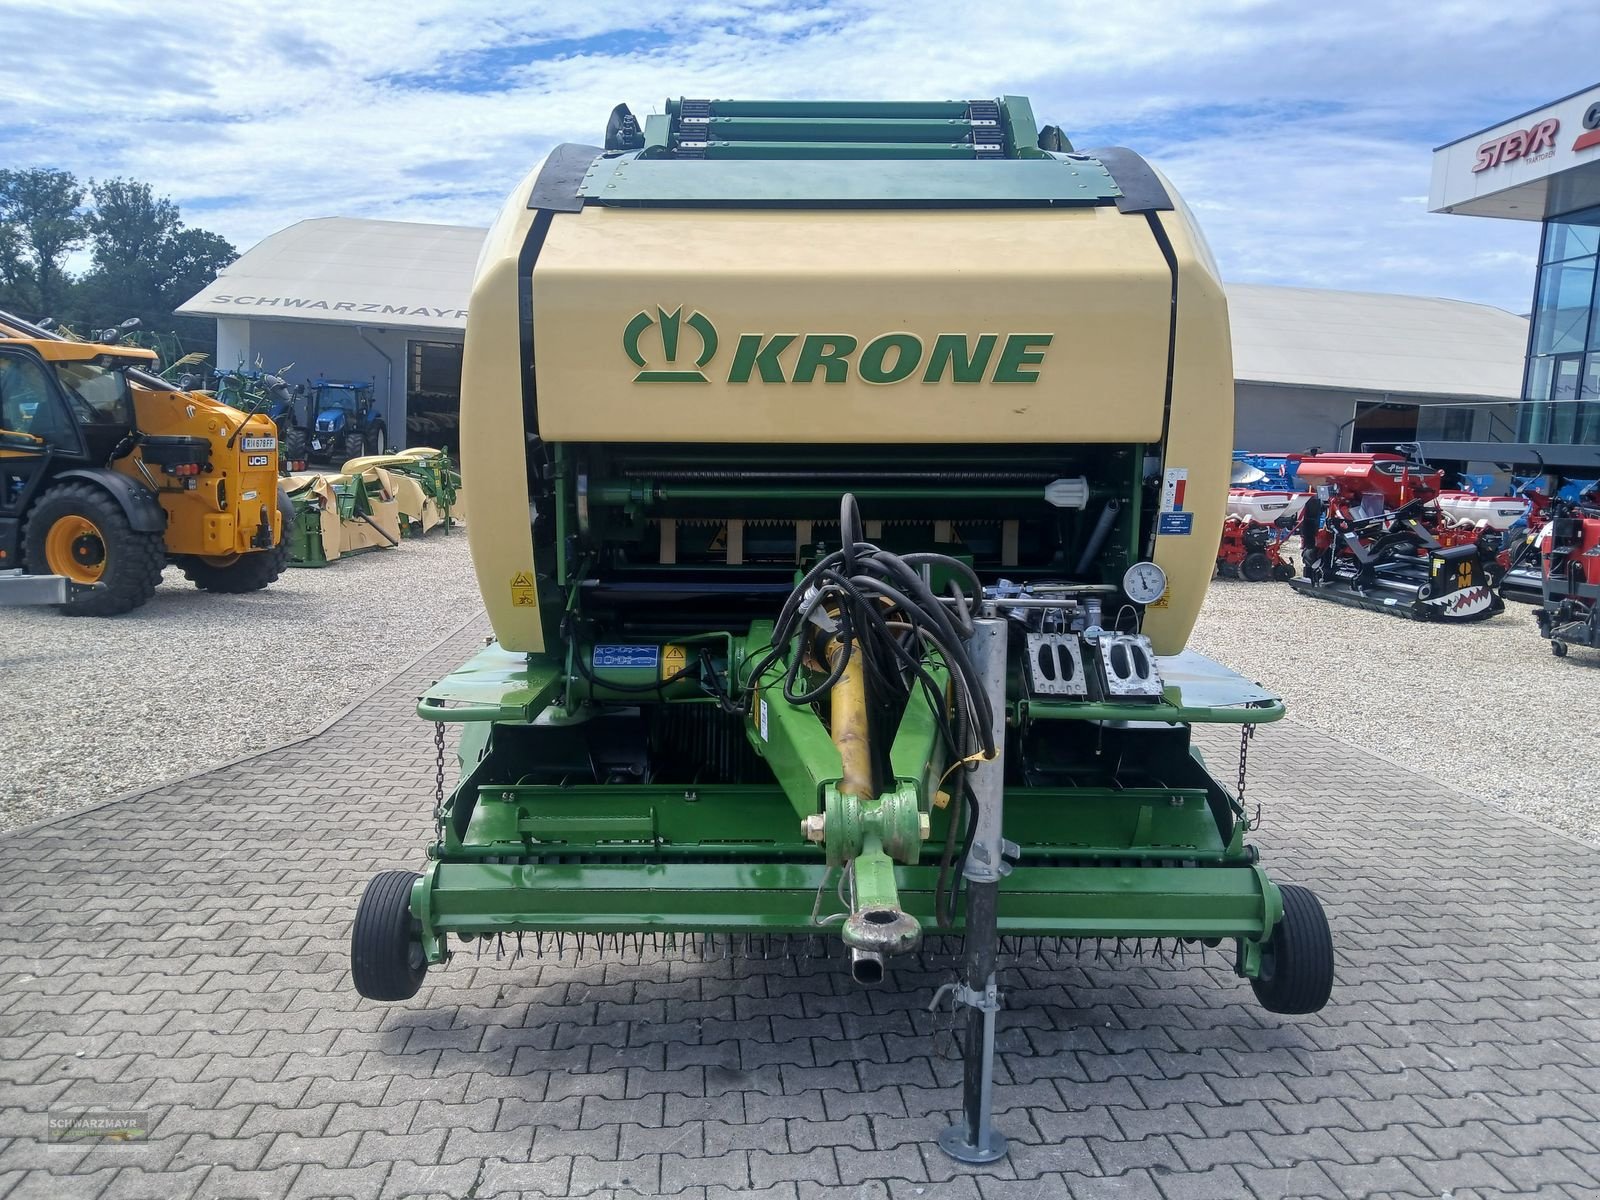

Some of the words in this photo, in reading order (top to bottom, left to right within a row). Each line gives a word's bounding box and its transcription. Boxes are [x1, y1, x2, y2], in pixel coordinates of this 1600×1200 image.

[1471, 118, 1560, 173] STEYR
[727, 331, 1054, 385] KRONE
[248, 456, 268, 465] JCB
